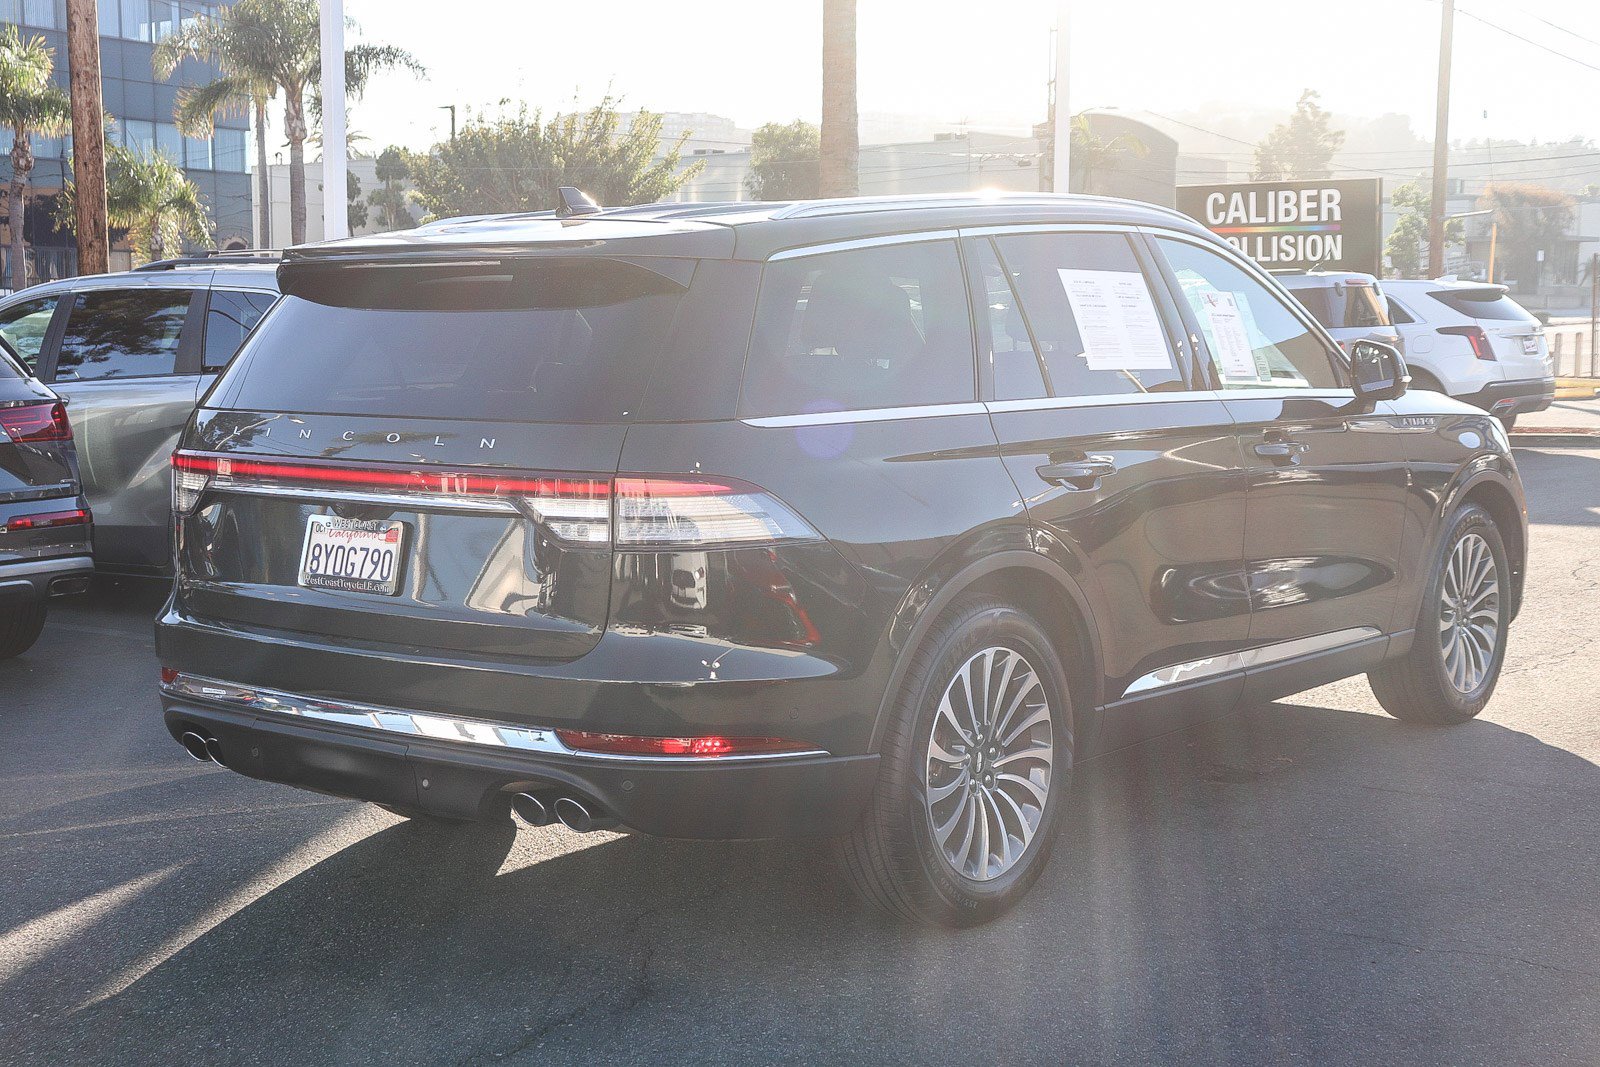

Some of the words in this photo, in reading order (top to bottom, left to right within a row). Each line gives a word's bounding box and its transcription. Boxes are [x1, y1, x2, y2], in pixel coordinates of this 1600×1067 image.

[1206, 188, 1342, 225] CALIBER
[1226, 234, 1342, 262] LLISION
[233, 426, 496, 449] LINCOLN
[309, 543, 393, 581] 8YOG790
